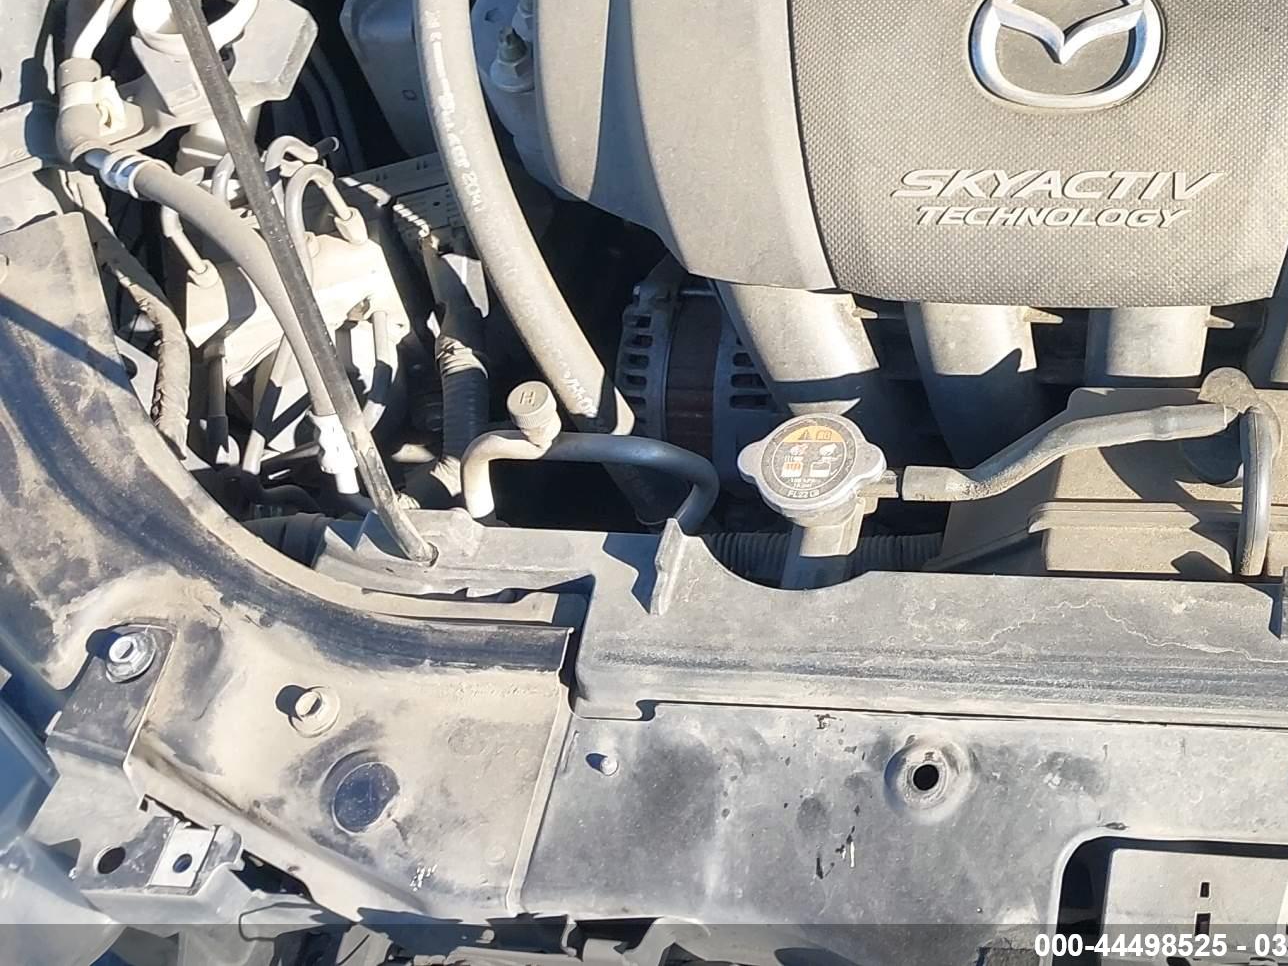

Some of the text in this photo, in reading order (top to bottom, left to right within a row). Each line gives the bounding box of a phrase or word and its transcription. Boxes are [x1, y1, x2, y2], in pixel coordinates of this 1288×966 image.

[890, 169, 1224, 201] SKYACTIV
[916, 206, 1192, 229] TECHNOLOGY
[519, 391, 536, 405] H
